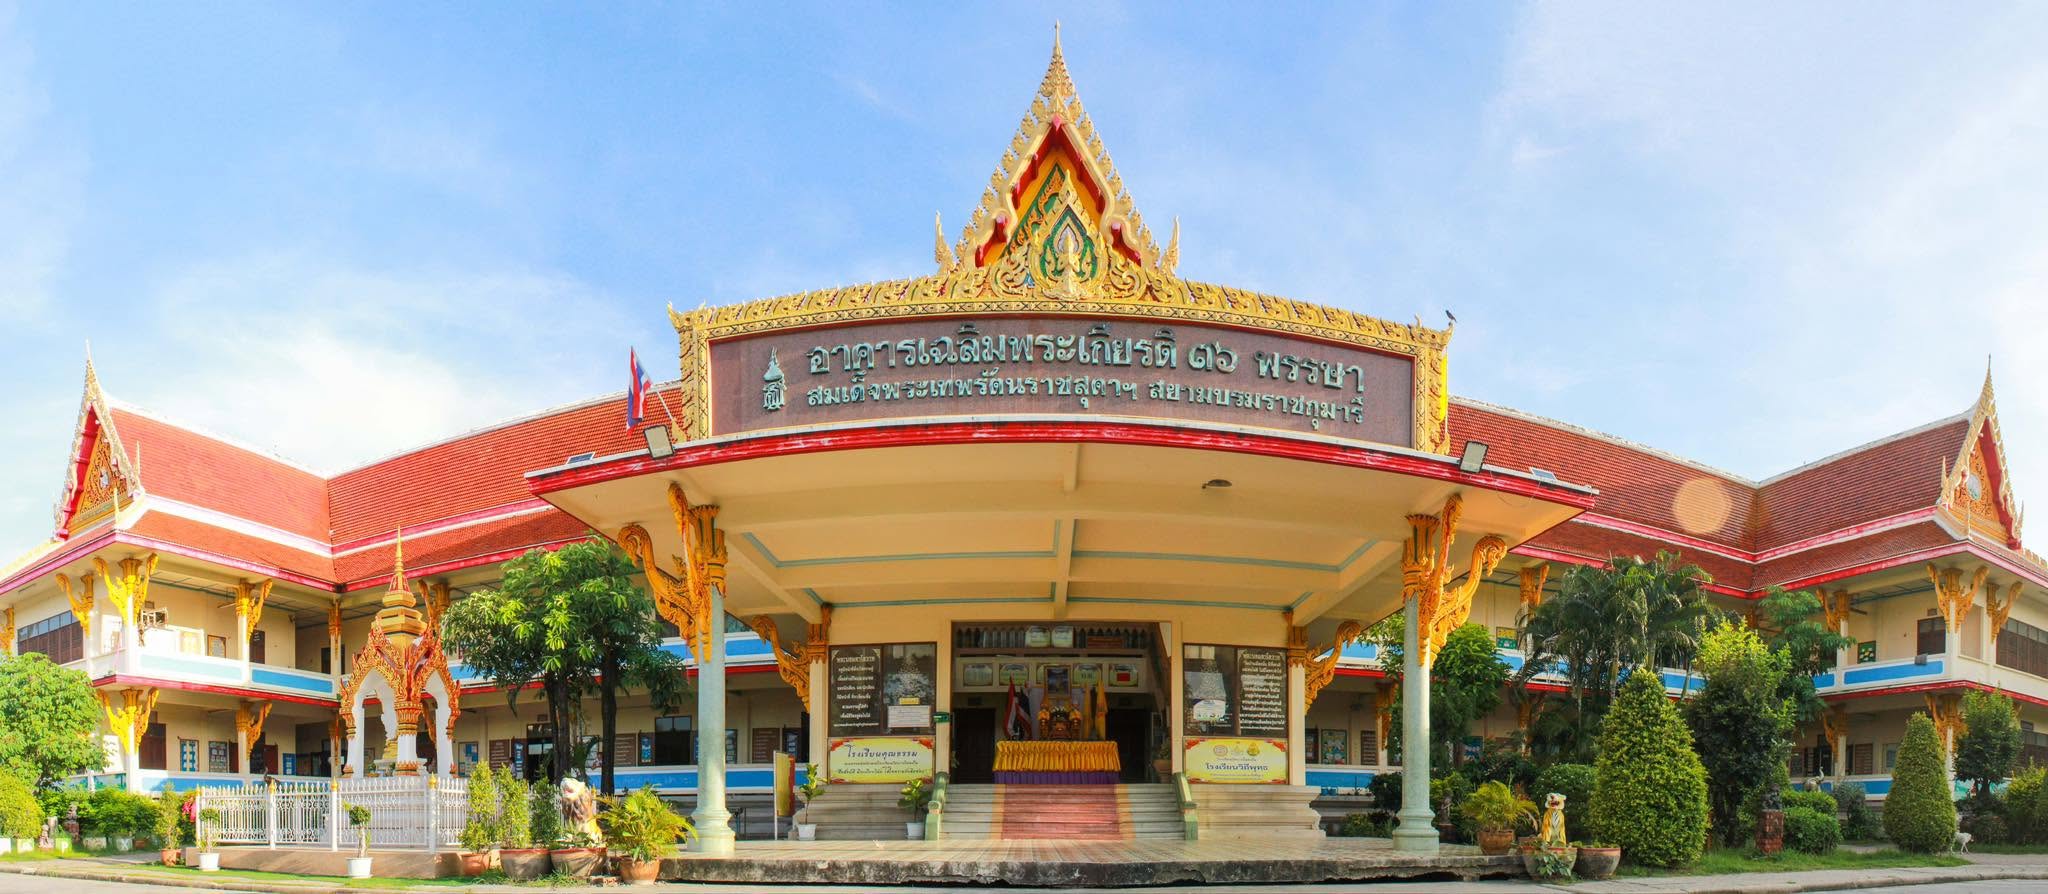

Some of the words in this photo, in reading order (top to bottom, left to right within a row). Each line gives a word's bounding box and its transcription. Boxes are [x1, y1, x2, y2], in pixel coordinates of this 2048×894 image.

[806, 322, 1177, 374] อาคารเฉลิมพระเกียรติ
[1187, 340, 1240, 374] ๓๖
[1253, 350, 1365, 393] พรรษา
[807, 366, 1138, 409] สมเด็จพระเทพรัตนราชสุดาฯ
[1149, 379, 1365, 430] สยามบรมราชกุมารี
